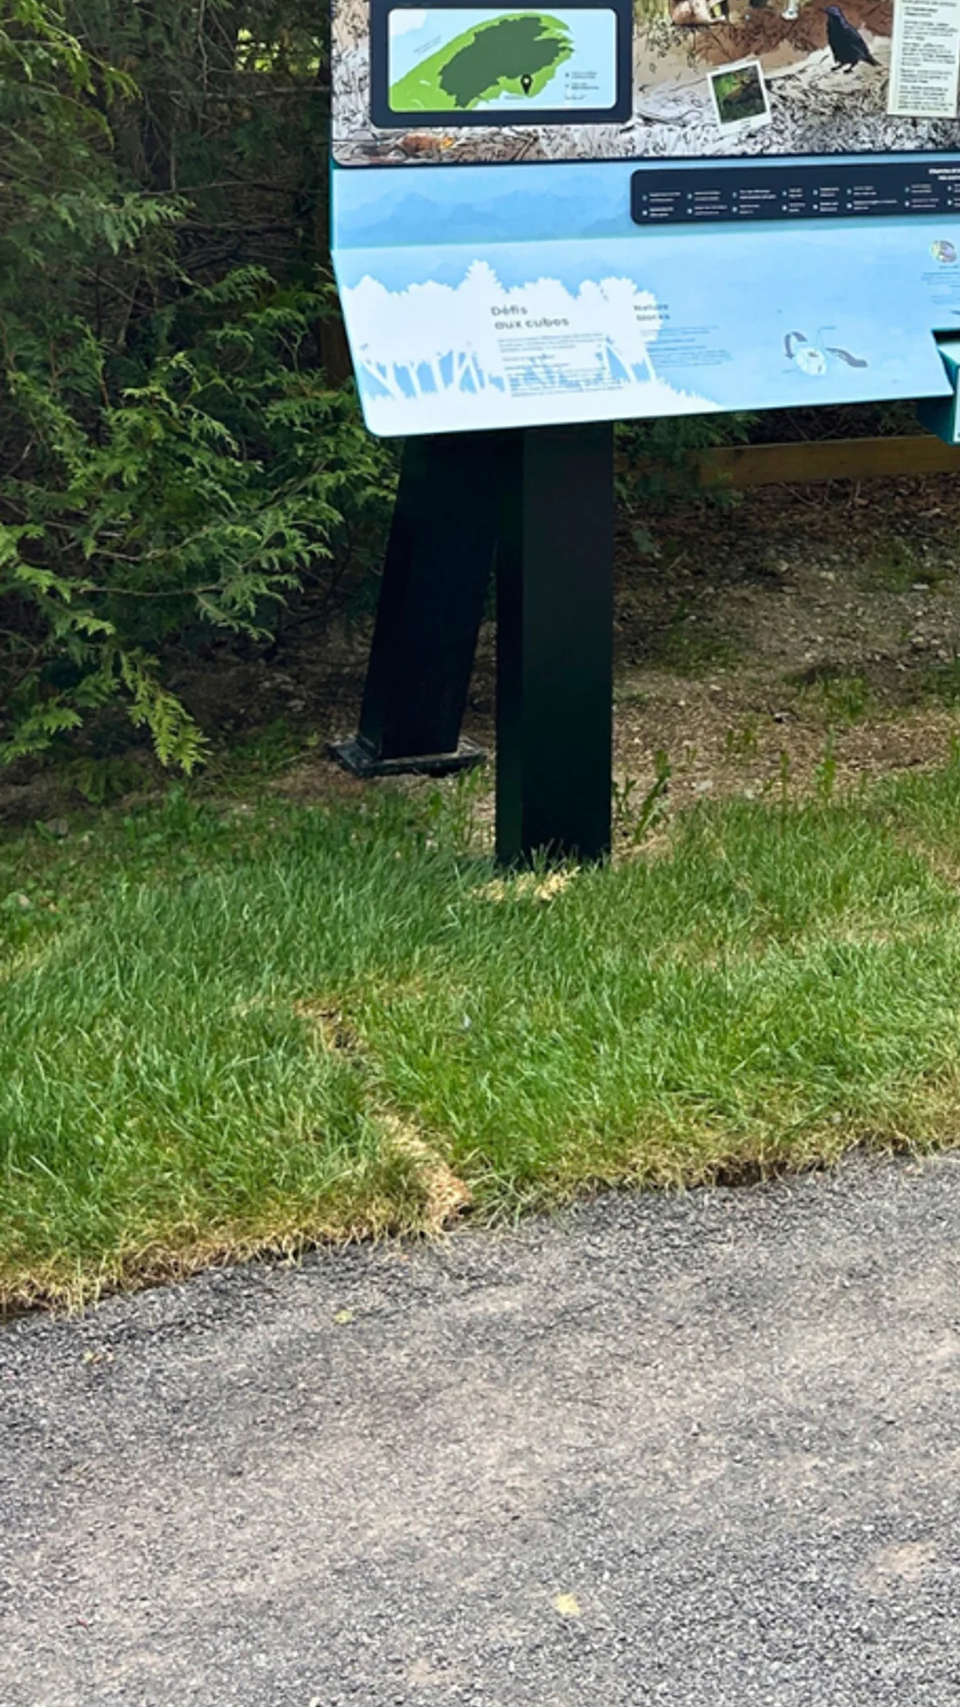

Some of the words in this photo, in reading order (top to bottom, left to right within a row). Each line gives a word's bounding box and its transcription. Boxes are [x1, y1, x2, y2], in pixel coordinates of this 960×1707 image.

[490, 303, 528, 317] Défis
[494, 321, 522, 330] aux
[525, 316, 570, 328] cubes
